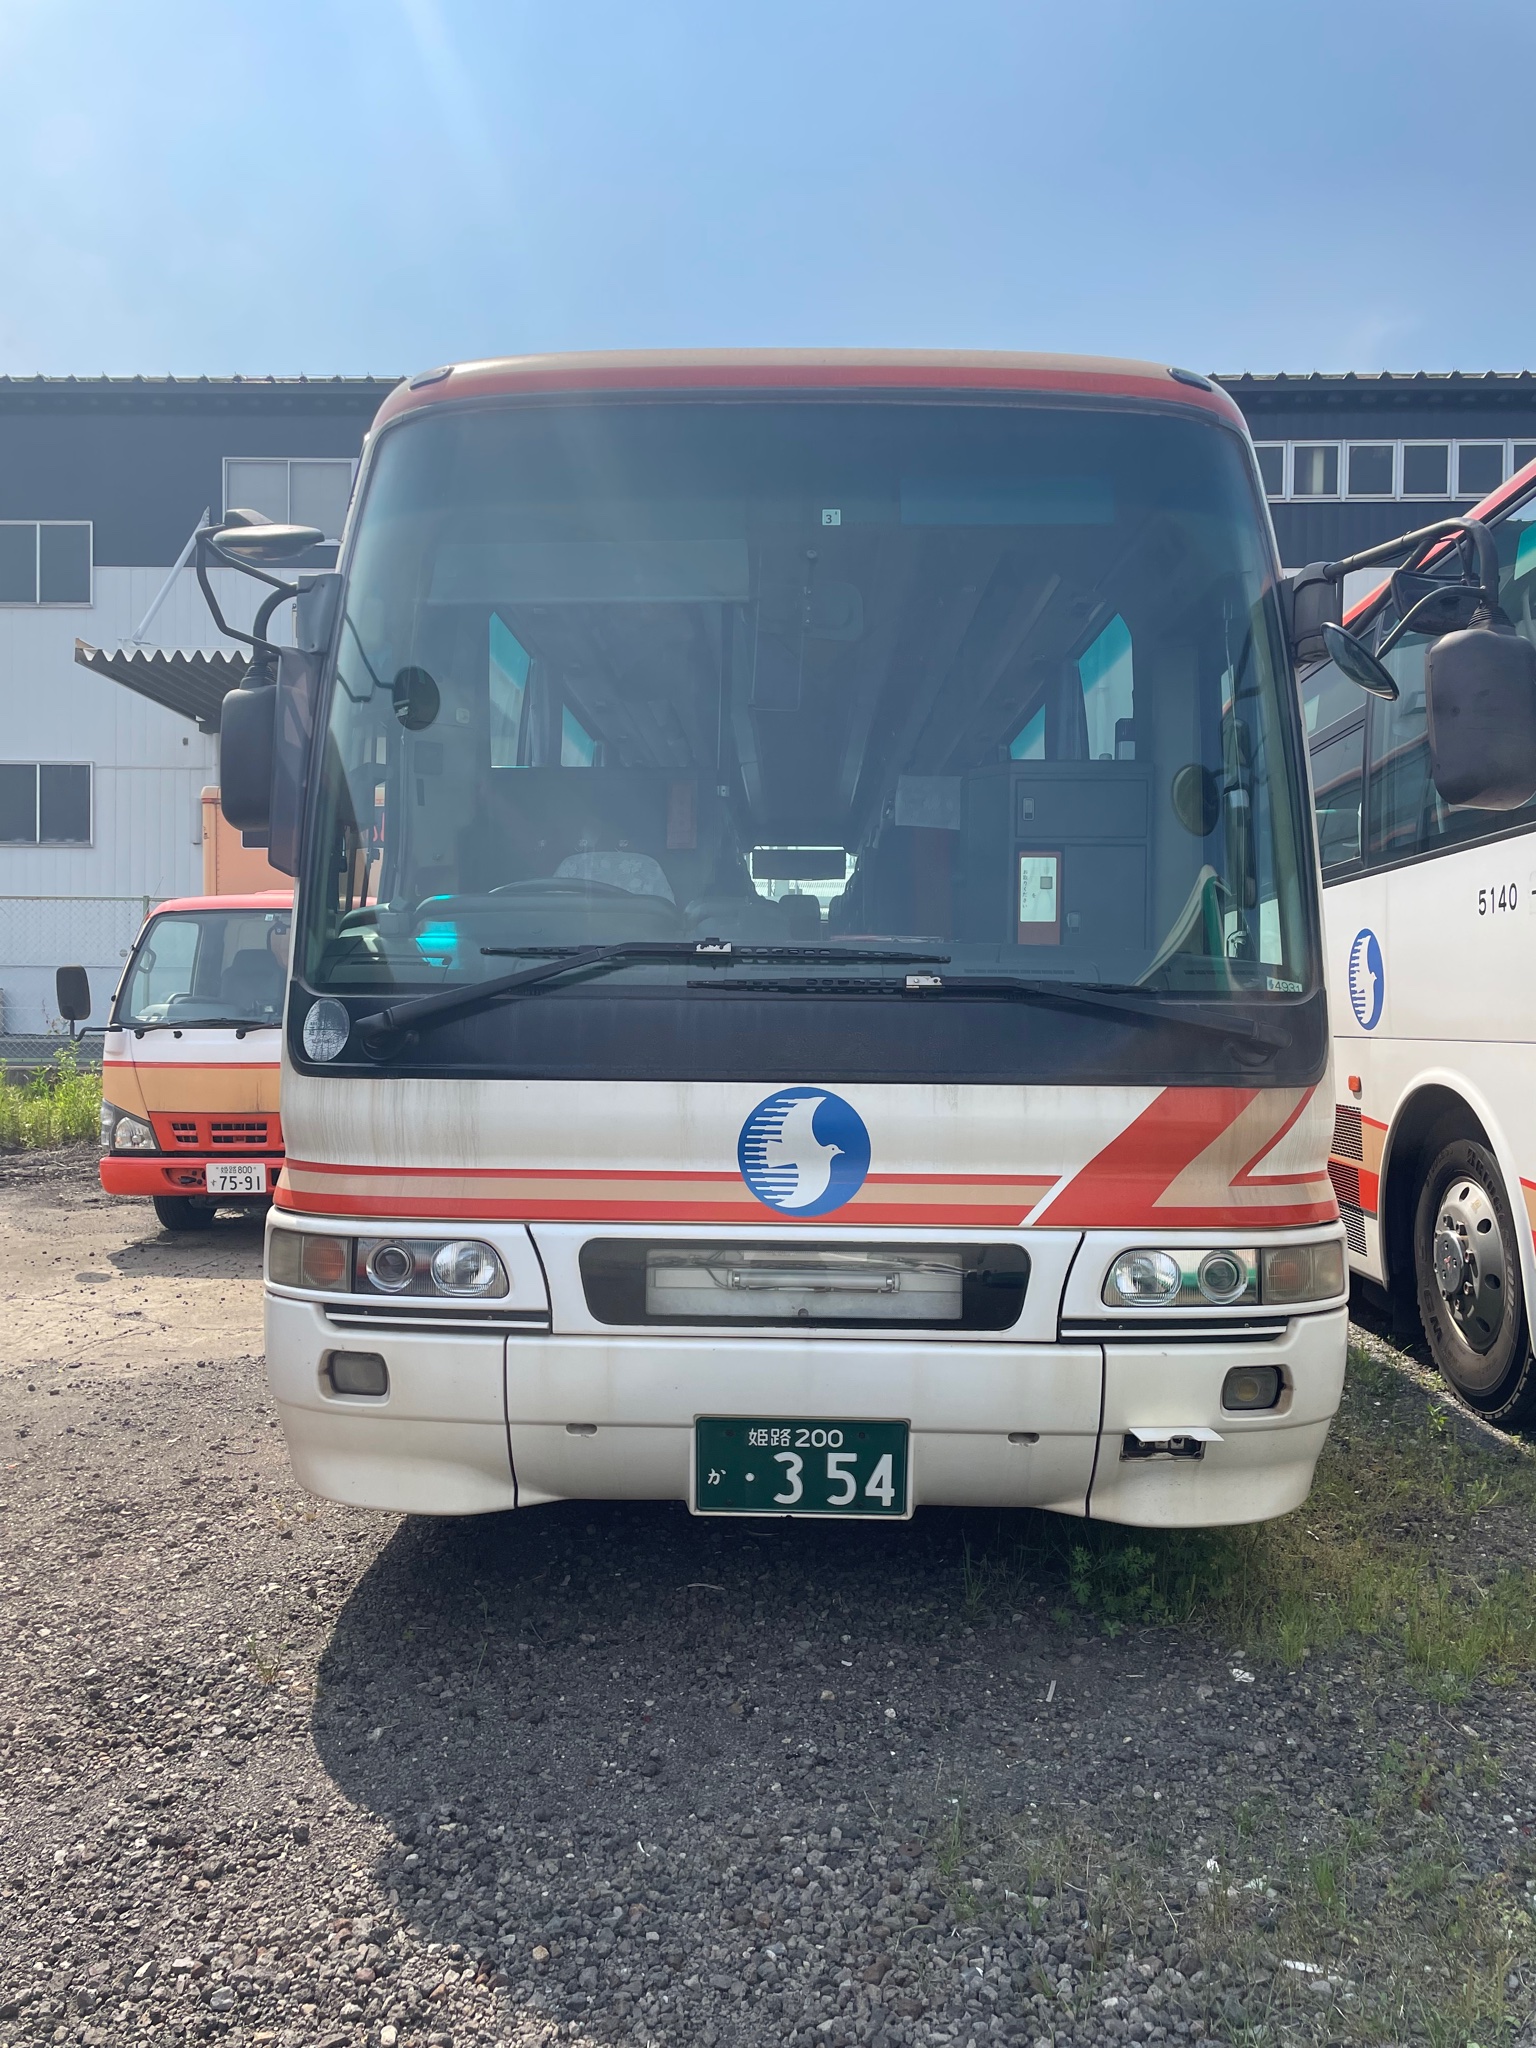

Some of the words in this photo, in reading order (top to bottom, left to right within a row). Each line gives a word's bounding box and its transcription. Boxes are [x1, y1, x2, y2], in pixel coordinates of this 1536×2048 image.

[1478, 883, 1517, 916] 5140
[219, 1175, 260, 1191] 75-91
[748, 1428, 844, 1448] 姫路200
[707, 1468, 727, 1485] か
